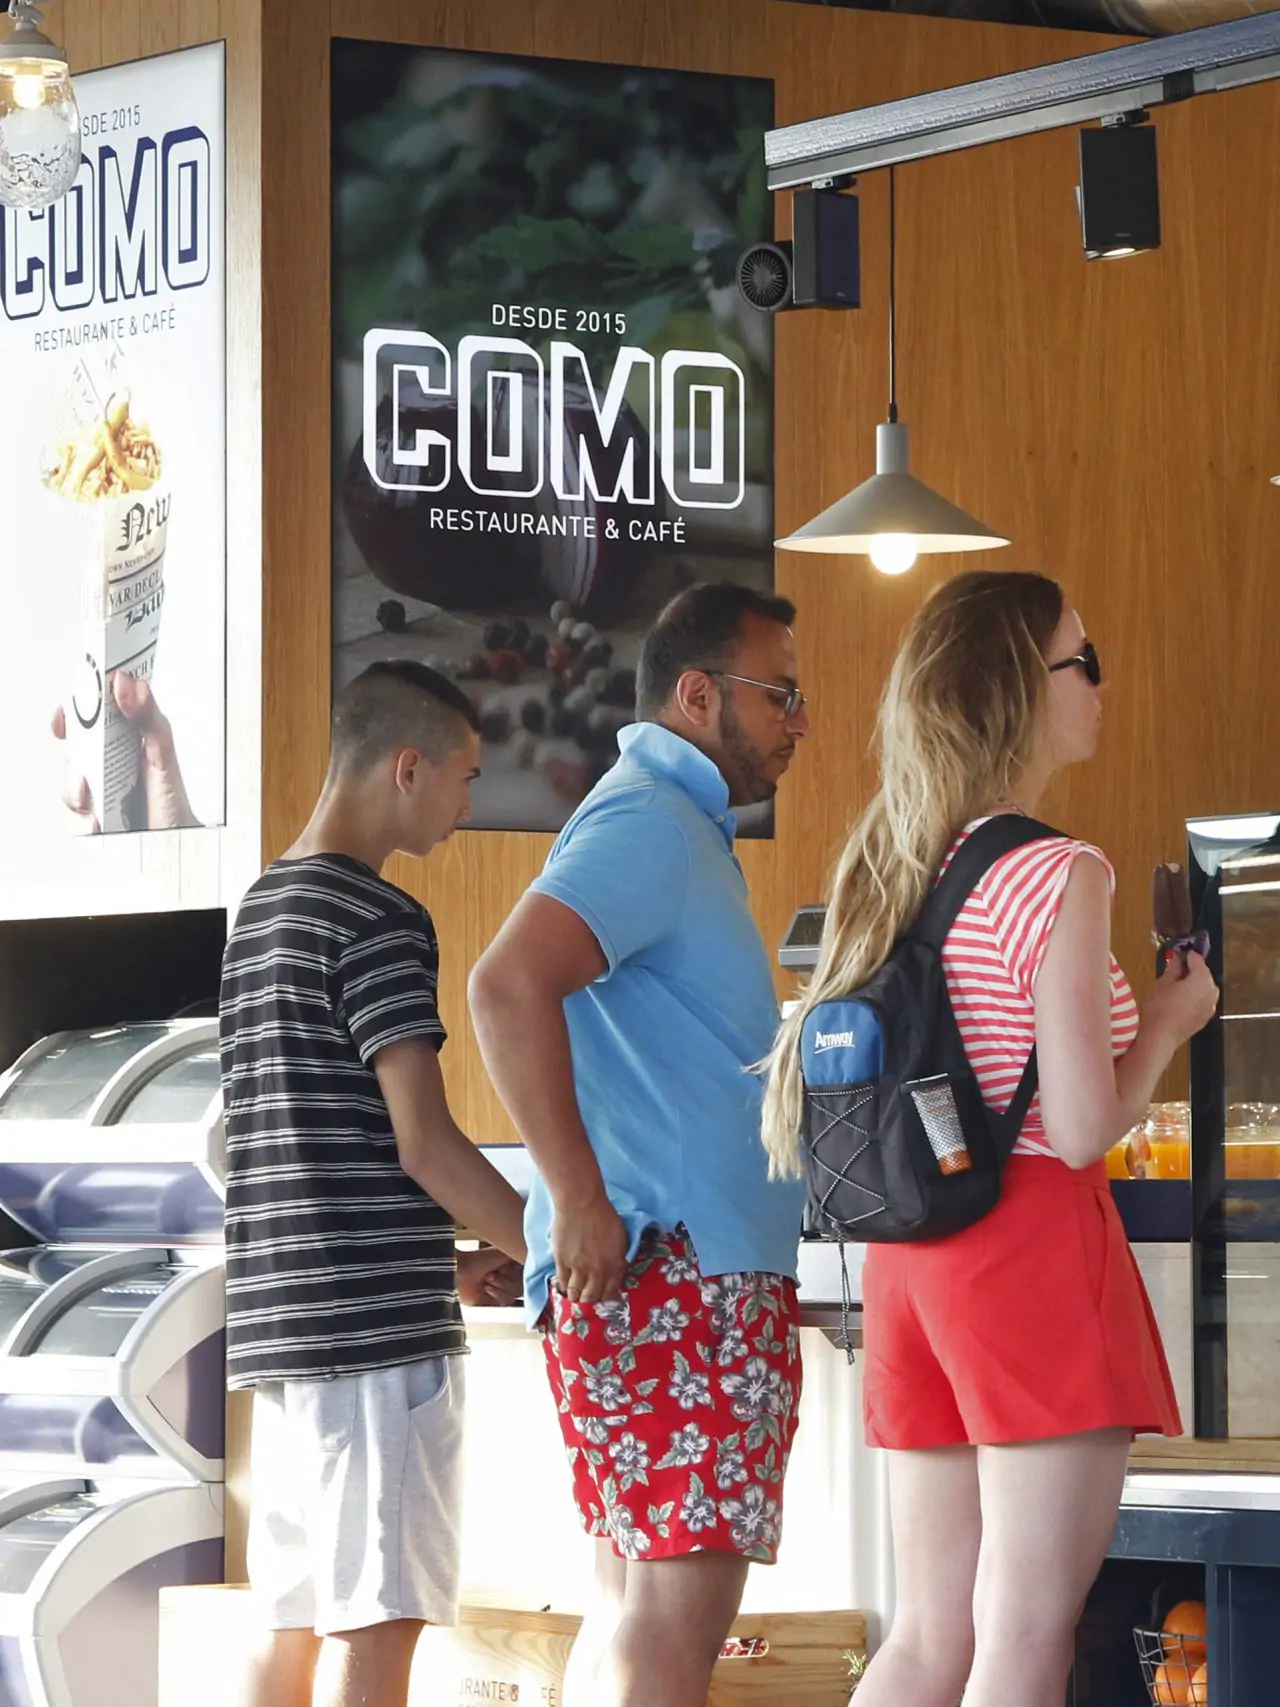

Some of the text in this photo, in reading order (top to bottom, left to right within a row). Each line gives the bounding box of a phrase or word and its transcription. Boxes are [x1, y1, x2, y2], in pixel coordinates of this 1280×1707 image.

[82, 105, 141, 137] SDE 2015
[0, 126, 210, 321] COMO
[34, 302, 176, 352] RESTAURANTE & CAFÉ
[492, 304, 627, 335] DESDE 2015
[363, 328, 745, 510] COMO
[430, 508, 687, 543] RESTAURANTE & CAFÉ
[815, 1030, 854, 1049] Amway
